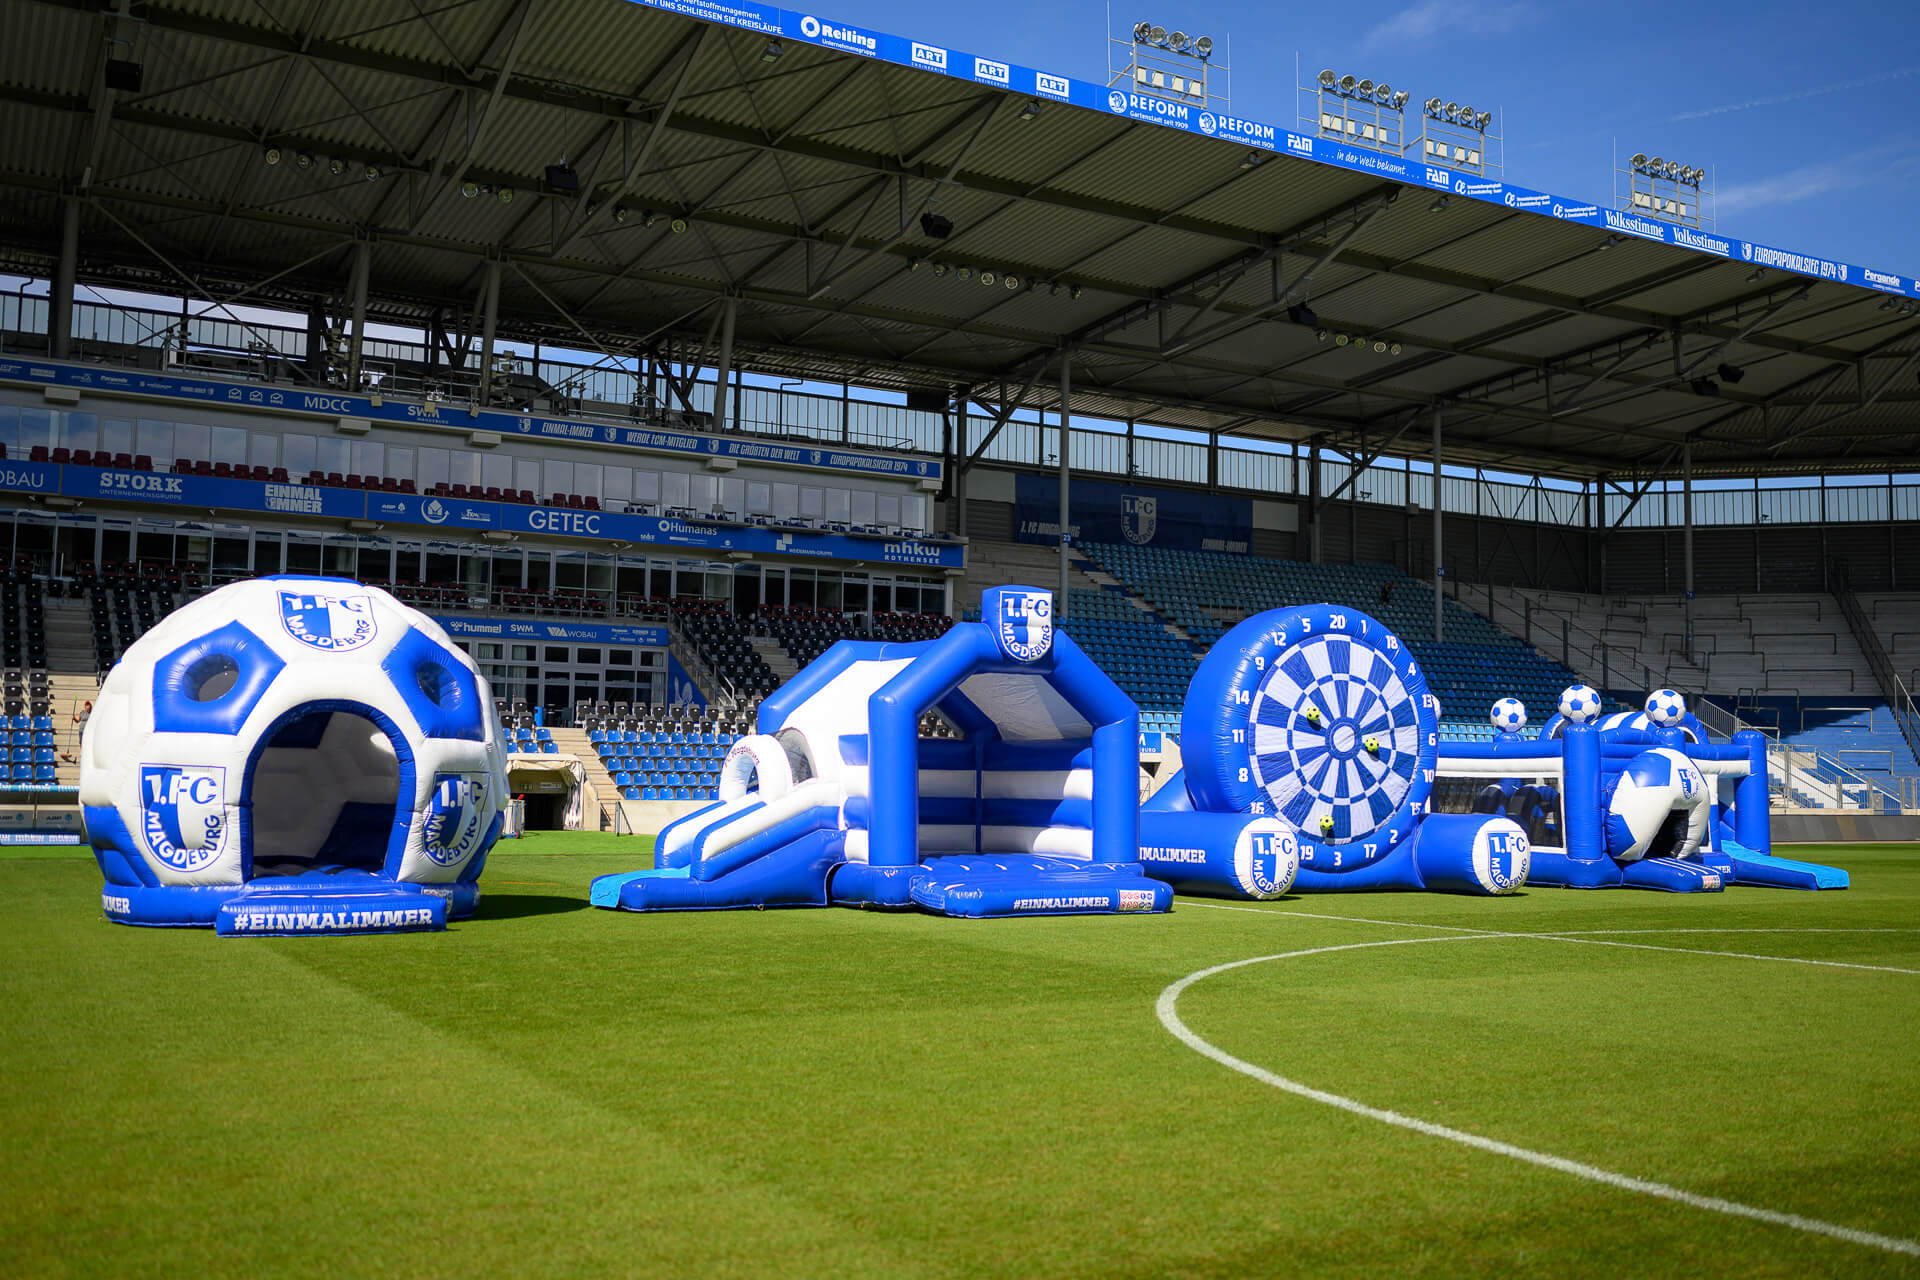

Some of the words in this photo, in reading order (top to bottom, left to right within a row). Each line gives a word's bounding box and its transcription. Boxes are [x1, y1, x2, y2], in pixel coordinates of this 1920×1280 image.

[660, 0, 675, 9] UNS
[676, 4, 722, 21] SCHLIESSEN
[724, 15, 736, 24] SIE
[738, 18, 784, 34] KREISLÄUFE.
[822, 24, 876, 49] Reiling
[822, 38, 876, 56] Unternehmensgruppe
[916, 48, 942, 62] ART
[980, 65, 1004, 78] ART
[1040, 79, 1065, 91] ART
[1130, 95, 1188, 120] REFORM
[1130, 110, 1162, 123] Gartenstadt
[1175, 120, 1188, 129] 1909
[1219, 116, 1274, 140] REFORM
[1218, 131, 1250, 144] Gartenstadt
[1261, 141, 1274, 149] 1909
[1288, 134, 1312, 152] FAM
[1336, 150, 1344, 160] in
[1345, 152, 1358, 164] der
[1360, 155, 1376, 168] Welt
[1376, 159, 1406, 175] bekannt
[1426, 167, 1449, 185] FAM
[1605, 210, 1664, 238] Volksstimme
[1672, 226, 1730, 253] Volksstimme
[1754, 246, 1819, 275] EUROPAPOKALSIEG
[1820, 261, 1837, 279] 1974
[304, 396, 351, 412] MDCC
[542, 422, 594, 438] EINMAL-IMMER
[728, 443, 740, 454] DIE
[770, 448, 784, 459] DER
[784, 449, 800, 461] WELT
[100, 472, 183, 493] STORK
[99, 489, 182, 500] UNTERNEHMENSGRUPPE
[264, 484, 322, 501] EINMAL
[1123, 499, 1153, 514] 1.FC
[528, 510, 600, 534] GETEC
[670, 522, 718, 536] Humanas
[884, 541, 940, 557] mhkw
[884, 554, 940, 564] ROTHENSEE
[1004, 598, 1049, 618] 1.FC
[463, 622, 502, 634] hummel
[510, 624, 534, 633] SWM
[1302, 618, 1312, 633] 5
[1329, 614, 1346, 630] 20
[1360, 620, 1366, 634] 1
[286, 614, 370, 647] MAGDEBURG
[1004, 622, 1050, 658] MAGDEBURG
[1271, 631, 1286, 647] 12
[1385, 635, 1398, 650] 18
[1254, 656, 1265, 671] 9
[1408, 662, 1416, 676] 4
[1234, 690, 1250, 705] 14
[1422, 694, 1433, 709] 13
[1232, 728, 1245, 744] 11
[1428, 732, 1436, 746] 6
[1238, 767, 1249, 783] 8
[1424, 770, 1434, 784] 10
[145, 774, 216, 805] 1.FC
[436, 780, 484, 808] 1.FC
[1410, 802, 1422, 816] 15
[148, 811, 221, 865] MAGDEBURG
[426, 815, 477, 861] MAGDEBURG
[1389, 830, 1398, 844] 2
[1490, 836, 1526, 854] 1.FC
[1254, 836, 1293, 856] 1.FC
[1300, 846, 1314, 861] 19
[1364, 844, 1377, 859] 17
[1334, 852, 1342, 867] 3
[1253, 859, 1294, 892] MAGDEBURG
[1491, 858, 1527, 888] MAGDEBURG
[1013, 896, 1110, 910] #EINMALIMMER
[234, 908, 432, 930] #EINMALIMMER
